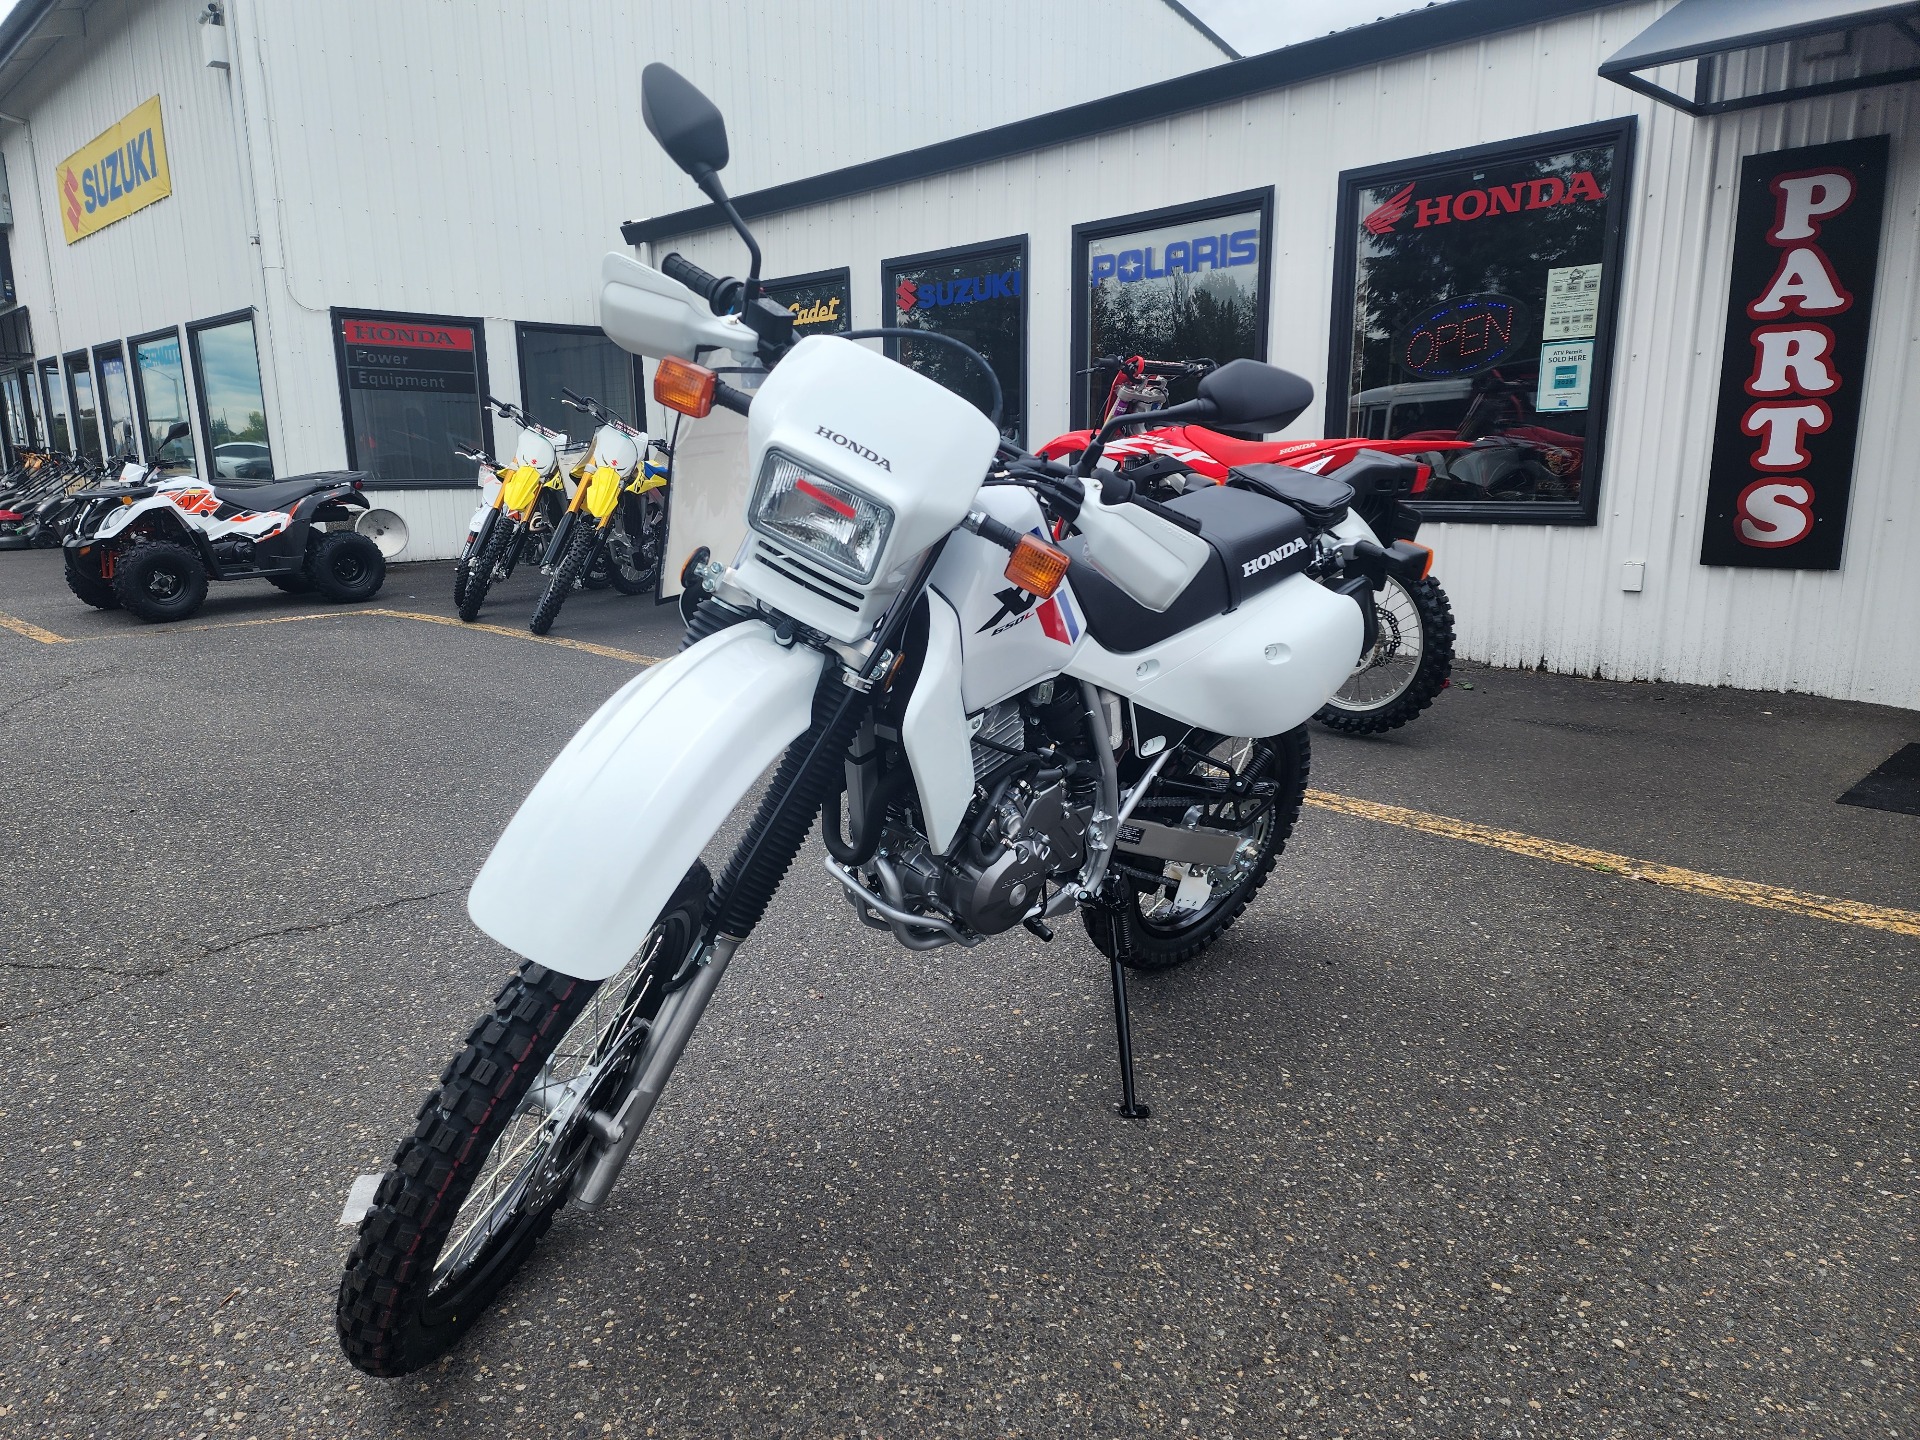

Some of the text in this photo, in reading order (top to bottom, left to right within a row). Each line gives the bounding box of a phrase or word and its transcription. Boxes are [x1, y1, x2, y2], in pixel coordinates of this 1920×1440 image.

[82, 128, 158, 214] SUZUKI
[1414, 171, 1605, 229] HONDA
[1092, 229, 1257, 288] POLARIS
[918, 270, 1021, 309] SUZUKI
[353, 325, 455, 345] HONDA
[1407, 305, 1514, 368] OPEN
[356, 349, 408, 365] Power
[1568, 354, 1587, 362] HERE
[1737, 170, 1854, 545] PARTS
[359, 371, 446, 389] Equipment
[815, 425, 892, 473] HONDA
[1279, 442, 1317, 455] HONDA
[1241, 536, 1308, 578] HONDA
[991, 611, 1035, 637] 650L
